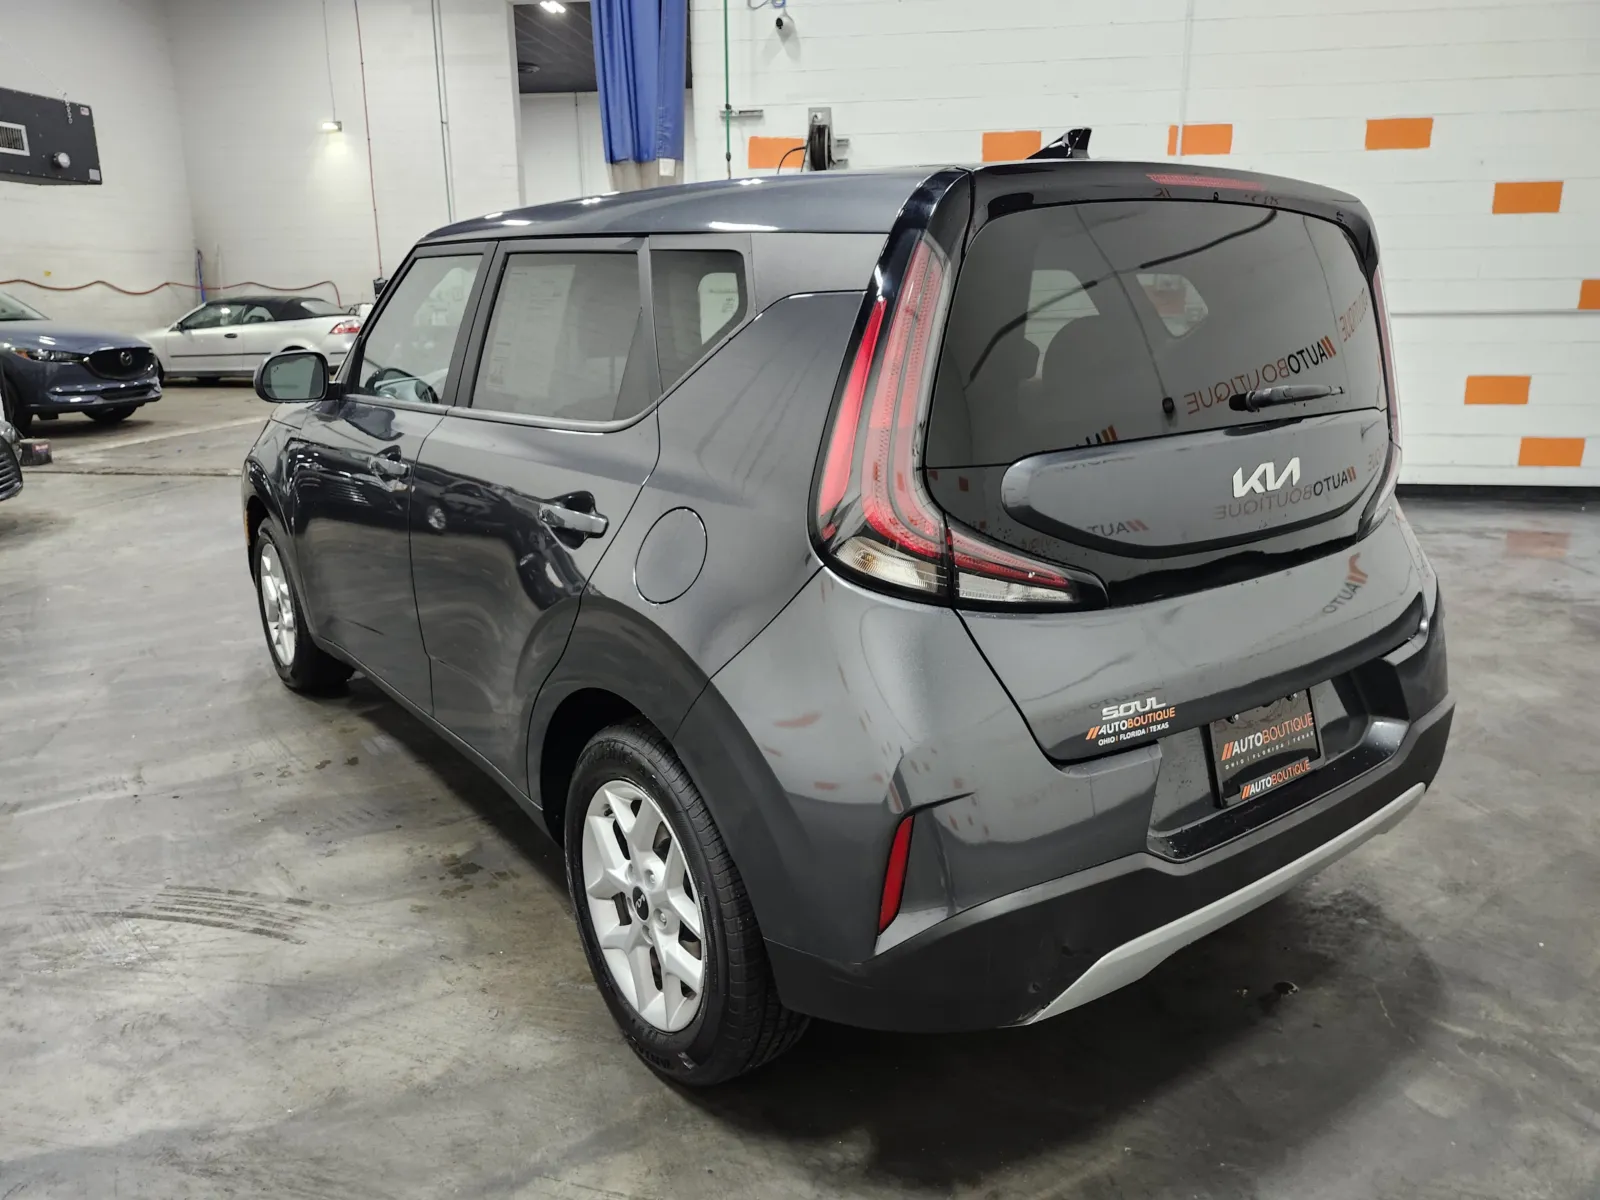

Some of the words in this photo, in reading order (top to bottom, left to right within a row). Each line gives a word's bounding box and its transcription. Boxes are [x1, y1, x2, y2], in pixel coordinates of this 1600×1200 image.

[1232, 456, 1300, 499] KIA
[1102, 697, 1166, 720] SOUL
[1098, 736, 1115, 747] OHIO
[1119, 728, 1146, 741] FLORIDA
[1149, 722, 1169, 733] TEXAS
